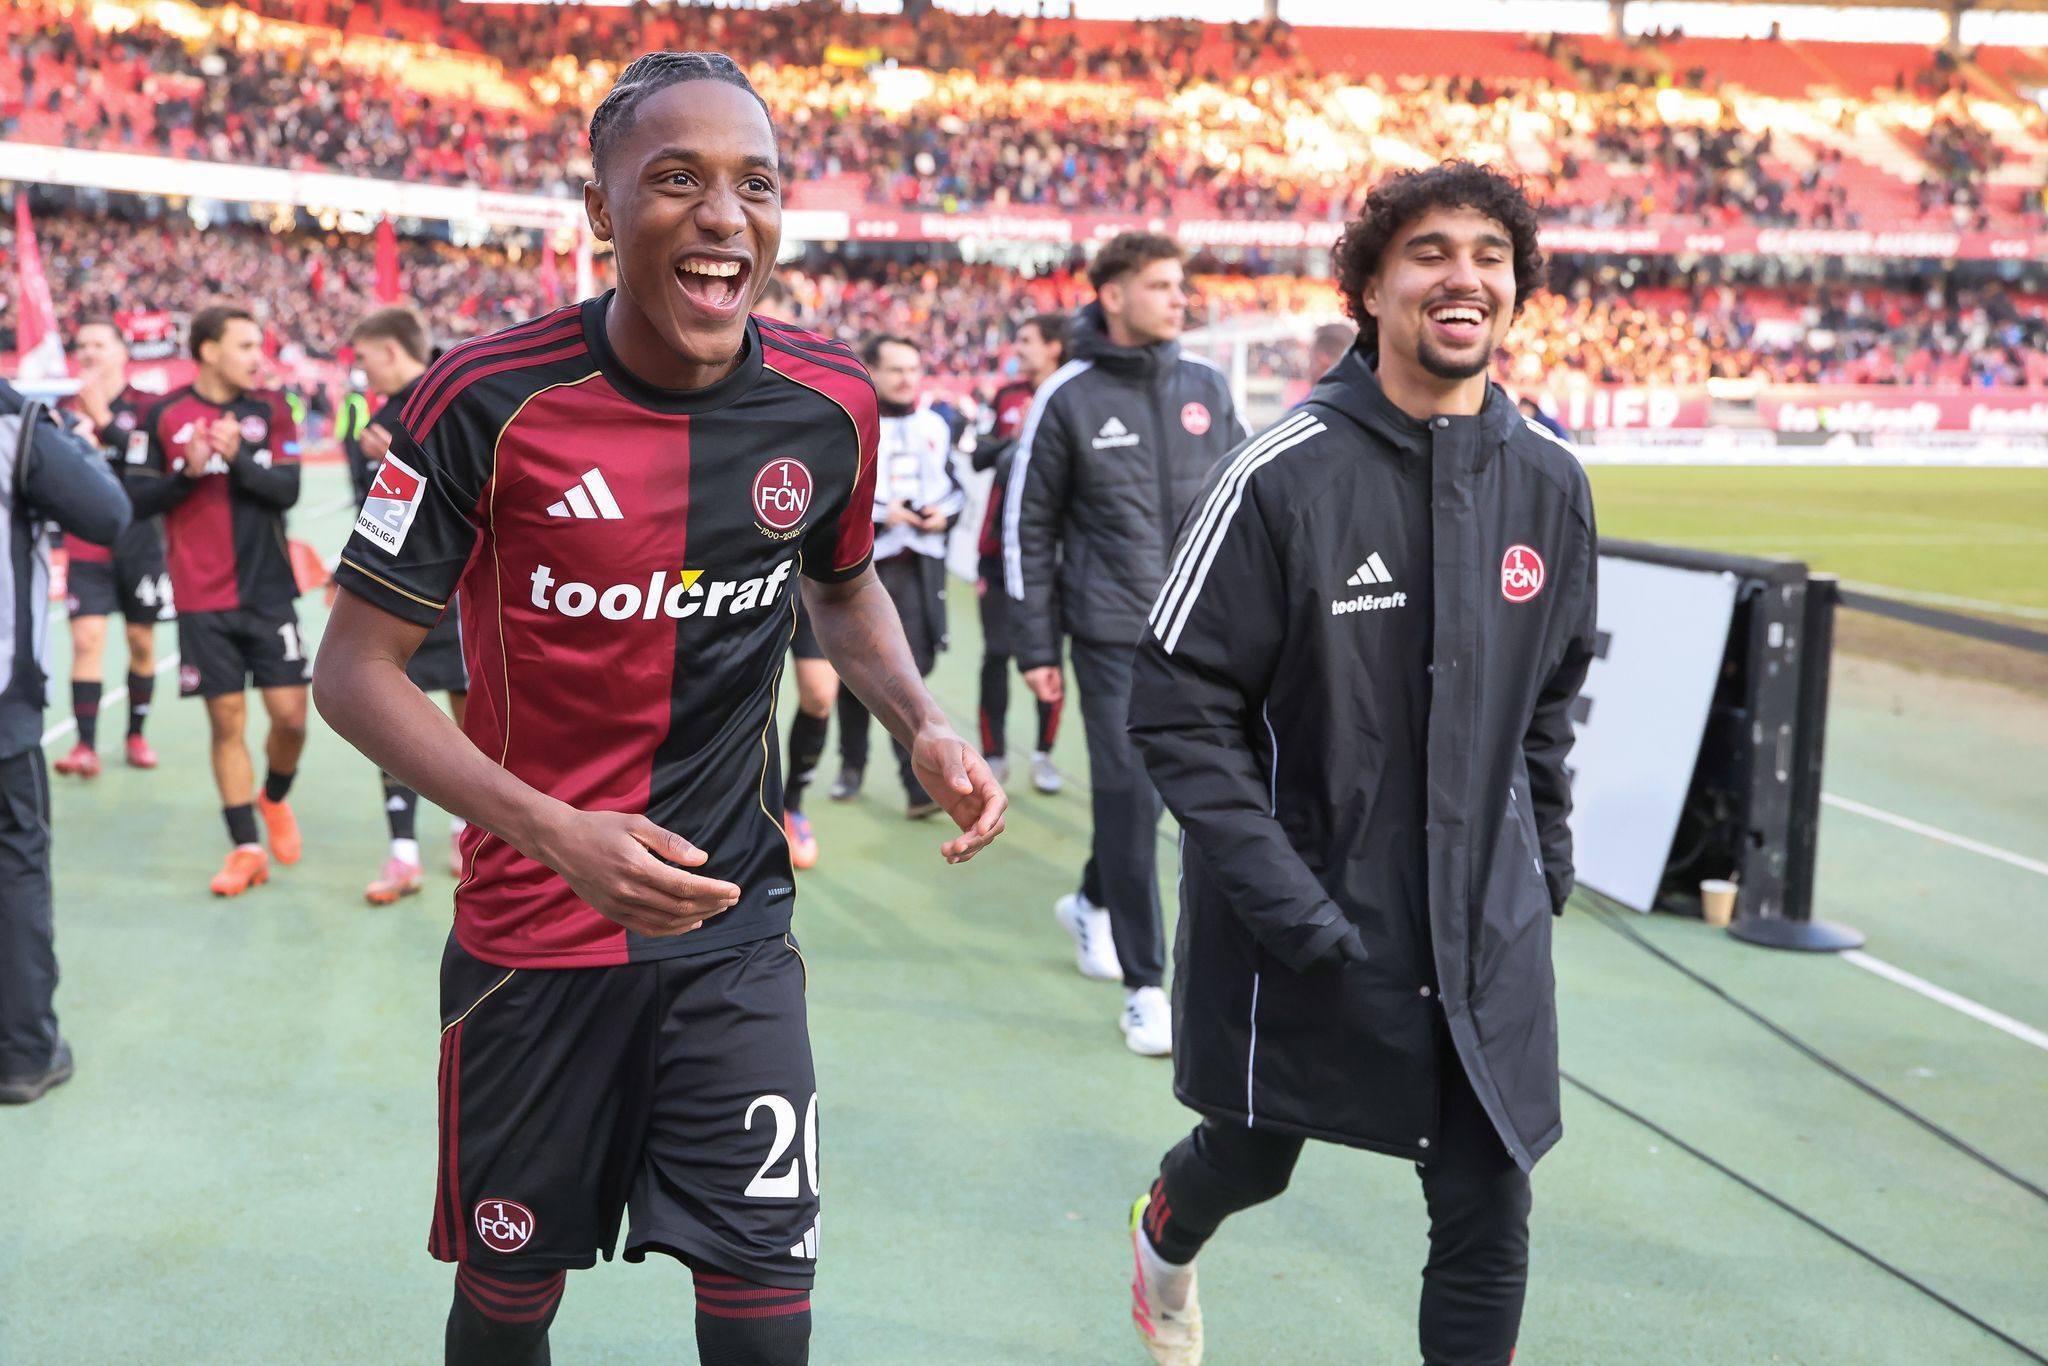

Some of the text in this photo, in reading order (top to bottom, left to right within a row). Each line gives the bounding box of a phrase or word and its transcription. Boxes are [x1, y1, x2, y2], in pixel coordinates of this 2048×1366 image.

[761, 487, 806, 511] FCN
[383, 500, 405, 527] 2
[530, 558, 793, 620] toolcraf
[1503, 568, 1538, 589] FCN
[1331, 591, 1407, 616] toolcraft
[480, 1216, 526, 1241] FCN
